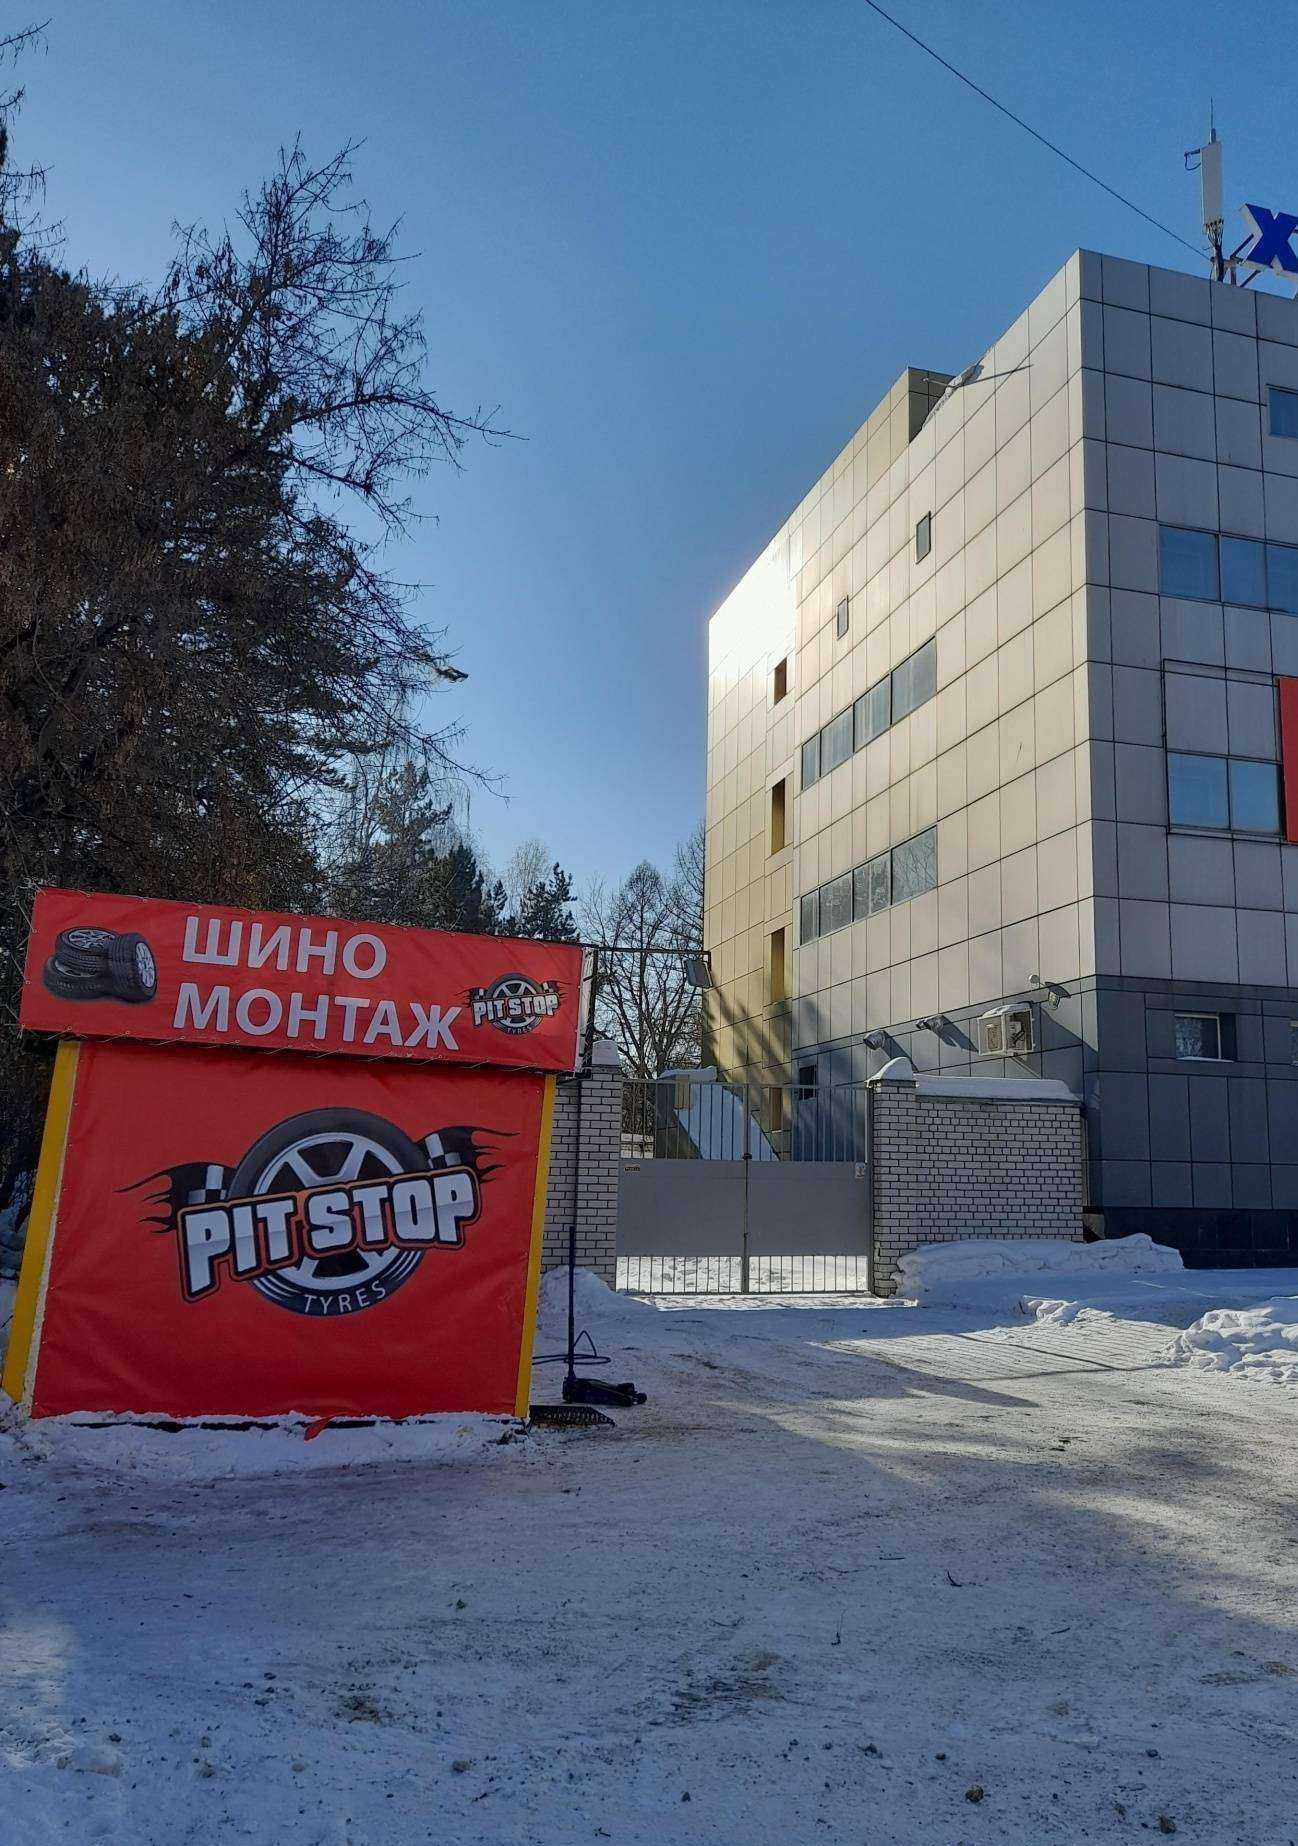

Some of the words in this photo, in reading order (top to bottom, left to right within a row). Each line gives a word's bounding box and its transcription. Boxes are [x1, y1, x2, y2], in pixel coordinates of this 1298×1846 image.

[182, 916, 387, 979] ШИНО
[173, 982, 463, 1050] МОНТАЖ
[473, 1000, 505, 1025] PIT
[508, 994, 558, 1015] STOP
[507, 1025, 532, 1035] TYRES
[184, 1200, 295, 1294] PIT
[308, 1173, 474, 1249] STOP
[303, 1279, 386, 1314] TYRES
